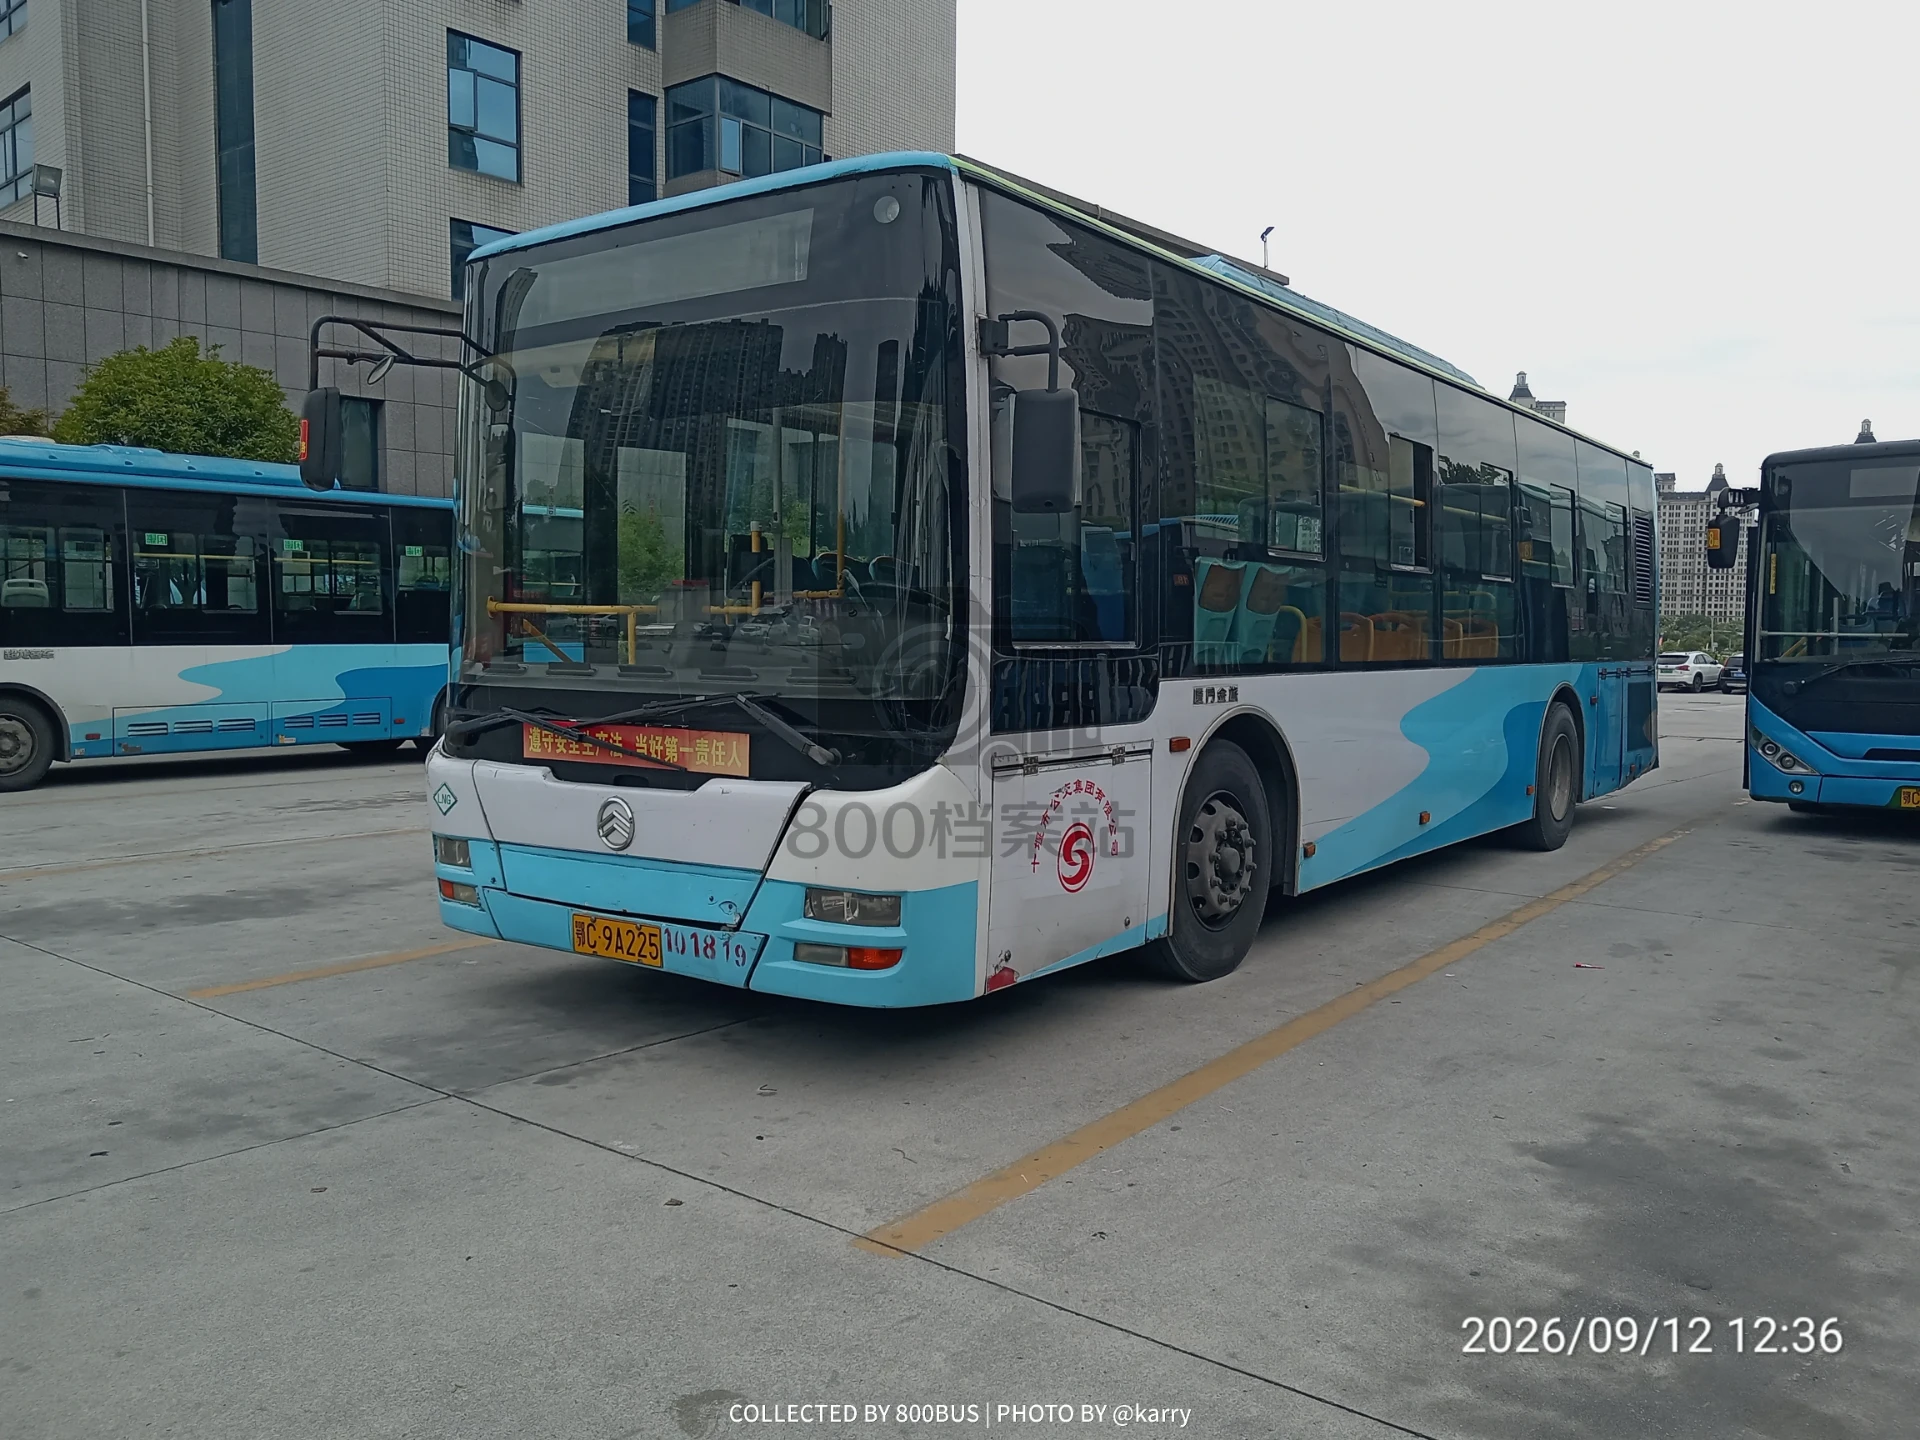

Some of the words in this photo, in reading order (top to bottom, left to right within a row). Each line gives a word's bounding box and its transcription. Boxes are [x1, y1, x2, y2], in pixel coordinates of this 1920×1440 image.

[636, 733, 742, 767] 当好第一责任人
[437, 793, 452, 805] LNG
[664, 926, 747, 967] 101819
